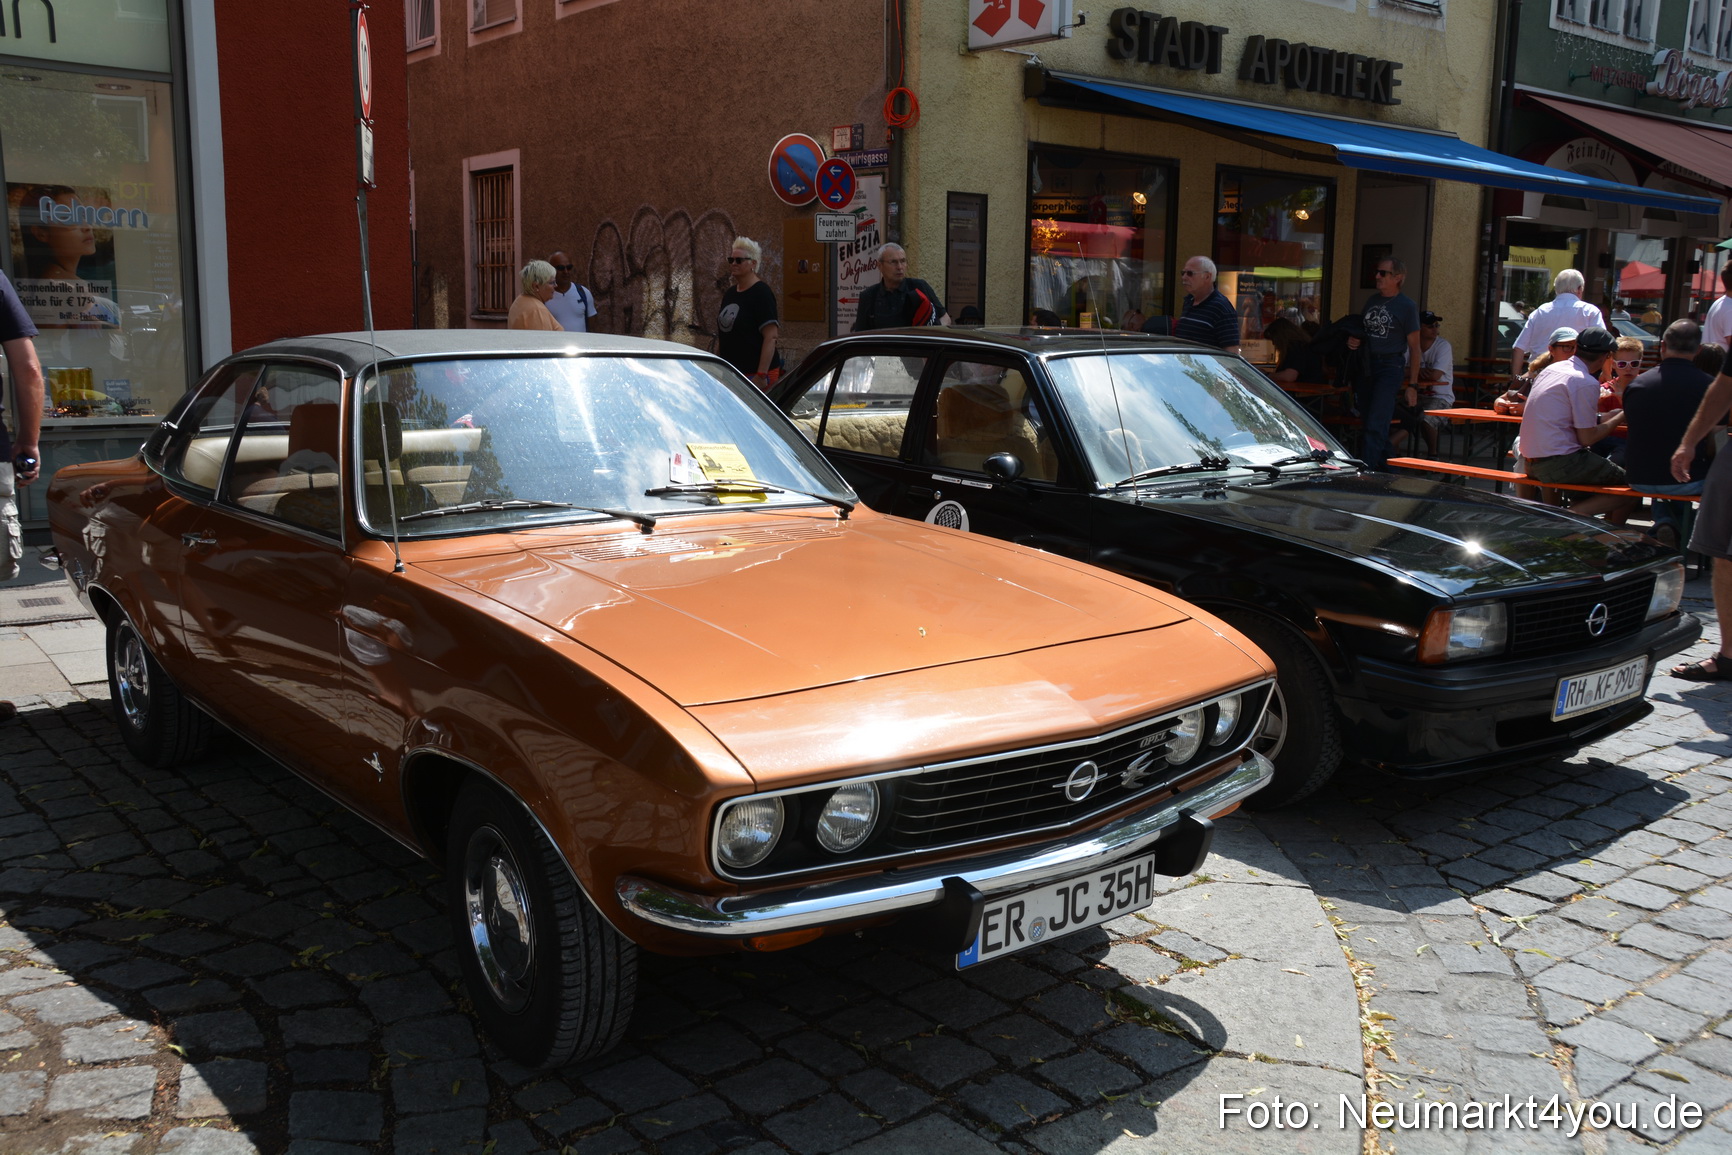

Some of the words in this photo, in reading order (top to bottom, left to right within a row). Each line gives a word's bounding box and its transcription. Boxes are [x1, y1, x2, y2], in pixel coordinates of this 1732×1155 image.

[1110, 7, 1228, 74] STADT
[1241, 35, 1403, 105] APOTHEKE
[1590, 64, 1647, 90] METZGEREI
[1651, 48, 1732, 109] Bögerl
[818, 216, 854, 229] Feuerwehr-
[825, 226, 847, 238] zufahrt
[839, 229, 880, 261] ENEZIA
[16, 281, 73, 293] Sonnenbrille
[76, 283, 85, 293] in
[88, 283, 109, 294] Ihrer
[50, 296, 62, 307] für
[66, 297, 74, 307] €
[1565, 679, 1587, 708] RH
[1594, 672, 1615, 701] KF
[1614, 664, 1637, 695] 990
[1140, 730, 1167, 748] OPEL
[981, 900, 1025, 955] ER
[1049, 881, 1089, 931] JC
[1097, 860, 1153, 916] 35H
